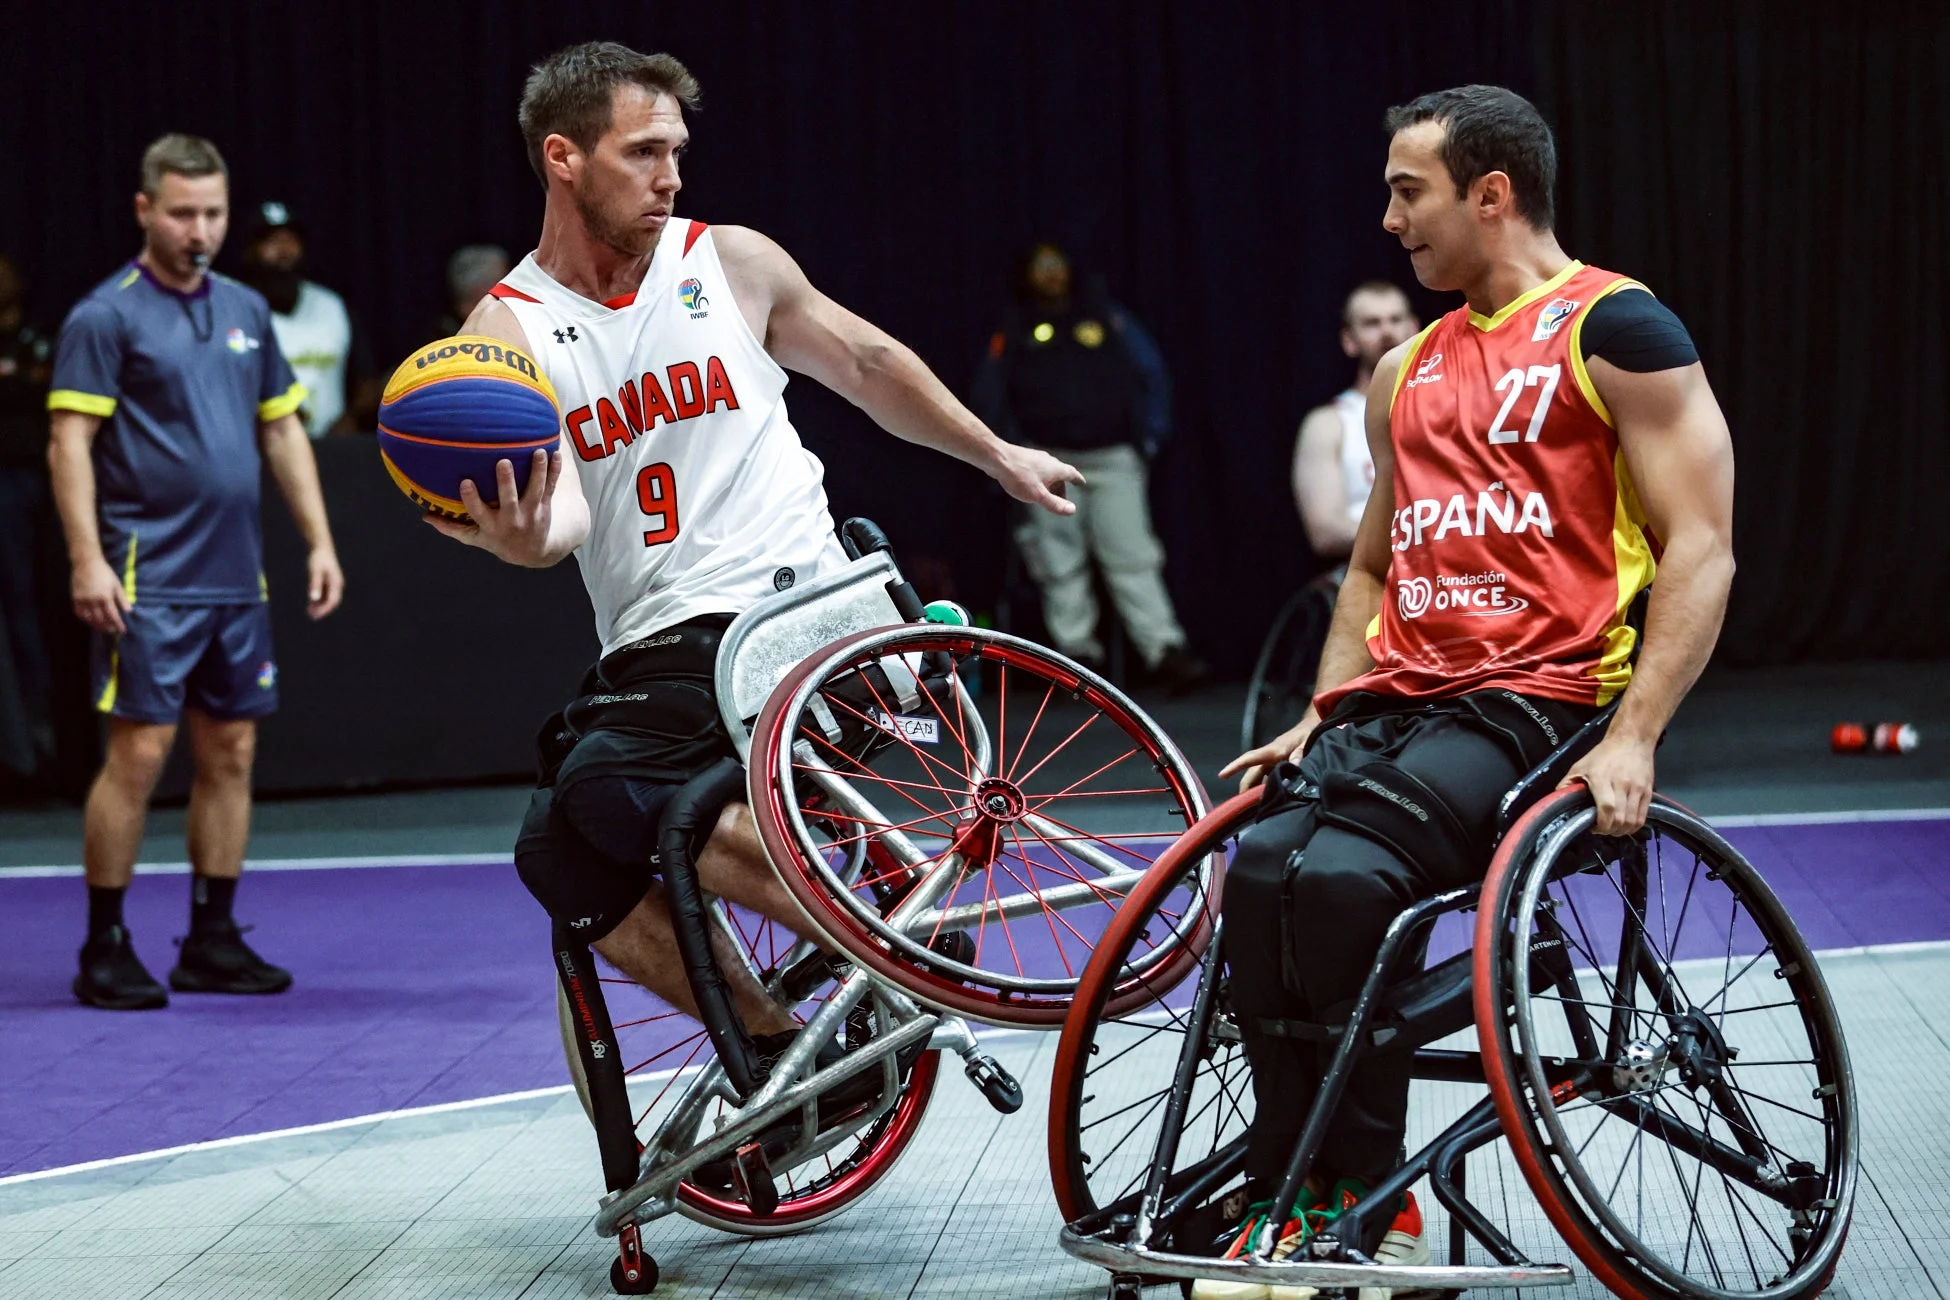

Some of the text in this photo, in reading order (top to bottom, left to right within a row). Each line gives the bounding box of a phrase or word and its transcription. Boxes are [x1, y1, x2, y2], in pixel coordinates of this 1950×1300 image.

[690, 311, 709, 320] IWBF
[415, 342, 539, 383] Wilson
[565, 355, 741, 462] CANADA
[1487, 363, 1562, 445] 27
[636, 462, 681, 547] 9
[1435, 586, 1506, 610] ONCE
[1436, 571, 1506, 588] Fundación
